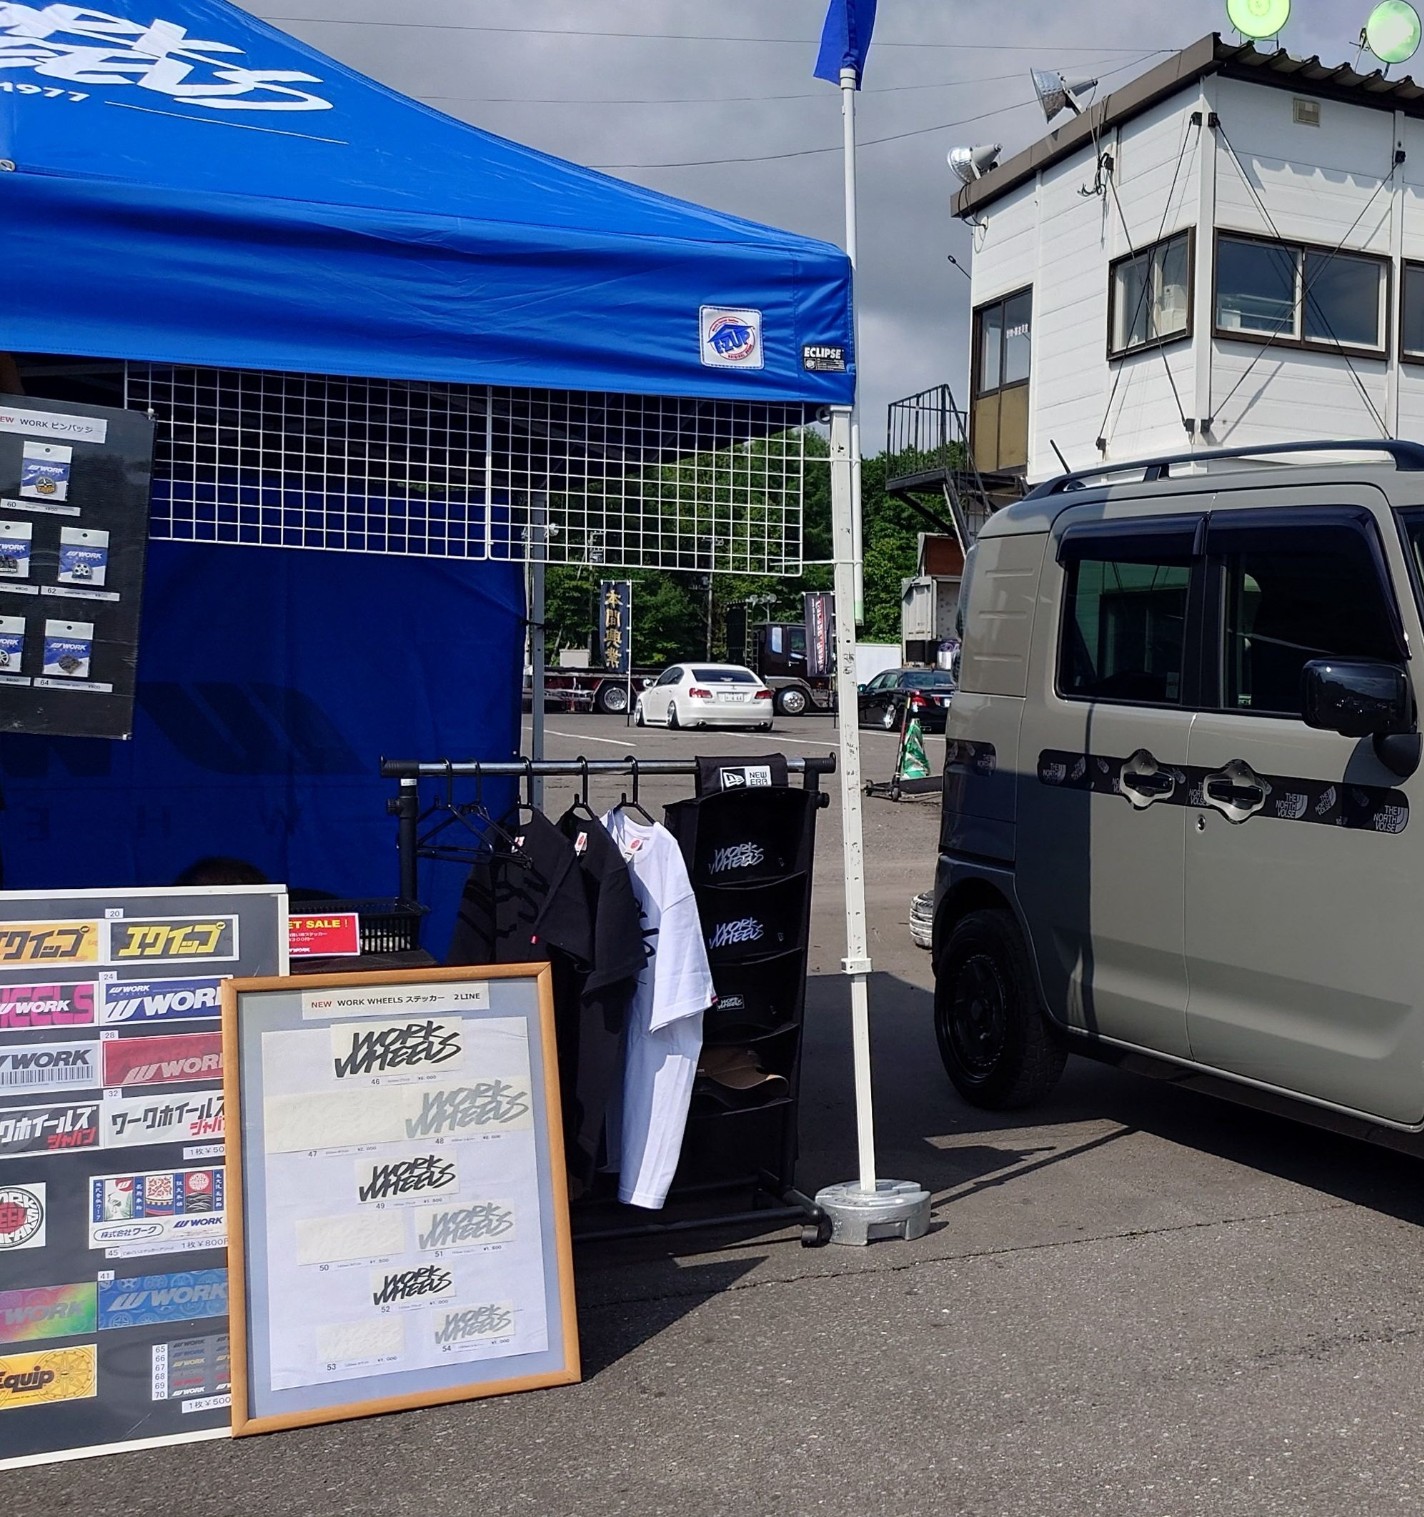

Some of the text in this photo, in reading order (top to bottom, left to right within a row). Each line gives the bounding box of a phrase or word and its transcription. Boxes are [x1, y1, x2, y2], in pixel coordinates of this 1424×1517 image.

[804, 347, 841, 359] ECLIPSE
[20, 418, 48, 429] WORK
[47, 587, 57, 595] 62
[603, 589, 623, 669] 本間興業
[749, 771, 768, 779] NEW
[1285, 792, 1298, 801] THE
[1275, 800, 1297, 811] NORTH
[1384, 804, 1399, 815] THE
[1373, 813, 1398, 824] NORTH
[1375, 820, 1398, 832] VOLSE
[109, 910, 120, 918] 20
[306, 920, 341, 929] SALE
[118, 920, 227, 957] エクイップ
[15, 1000, 71, 1014] WORK
[311, 1001, 332, 1009] NEW
[337, 998, 365, 1007] WORK
[367, 996, 403, 1006] WHEELS
[405, 994, 446, 1004] ステッカー
[351, 1019, 446, 1051] WORK
[12, 1048, 92, 1070] WORK
[333, 1031, 462, 1079] WHEELS
[107, 1089, 118, 1097] 32
[422, 1079, 513, 1107] WORK
[405, 1091, 530, 1139] WHEELS
[371, 1154, 447, 1180] WORK
[358, 1163, 457, 1203] WHEELS
[433, 1201, 503, 1224] WORK
[190, 1216, 223, 1227] WORK
[100, 1226, 158, 1240] 株式会社ワーク
[417, 1211, 515, 1250] WHEELS
[107, 1249, 119, 1257] 45
[434, 1250, 444, 1258] 51
[319, 1264, 330, 1272] 50
[382, 1264, 444, 1286] WORK
[151, 1282, 228, 1307] WORK
[372, 1271, 453, 1306] WHEELS
[5, 1302, 81, 1325] WORK
[380, 1305, 391, 1313] 52
[326, 1363, 337, 1371] 53
[183, 1386, 206, 1395] WORK
